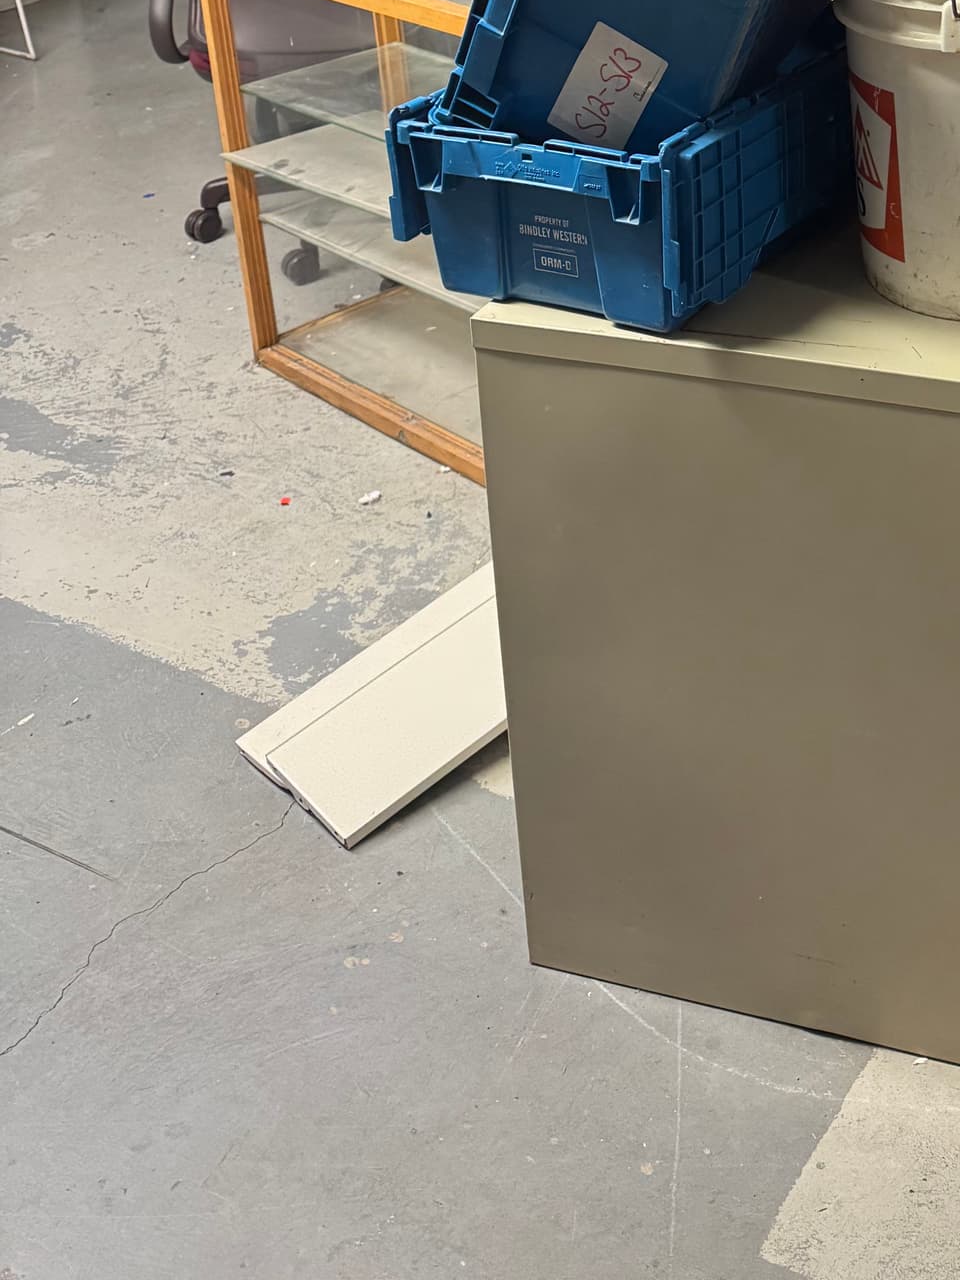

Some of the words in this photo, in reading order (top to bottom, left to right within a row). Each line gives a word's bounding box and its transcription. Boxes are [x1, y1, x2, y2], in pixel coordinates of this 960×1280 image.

[534, 215, 561, 227] PROPERTY
[519, 223, 551, 239] BINDLEY
[552, 230, 588, 246] WESTERN
